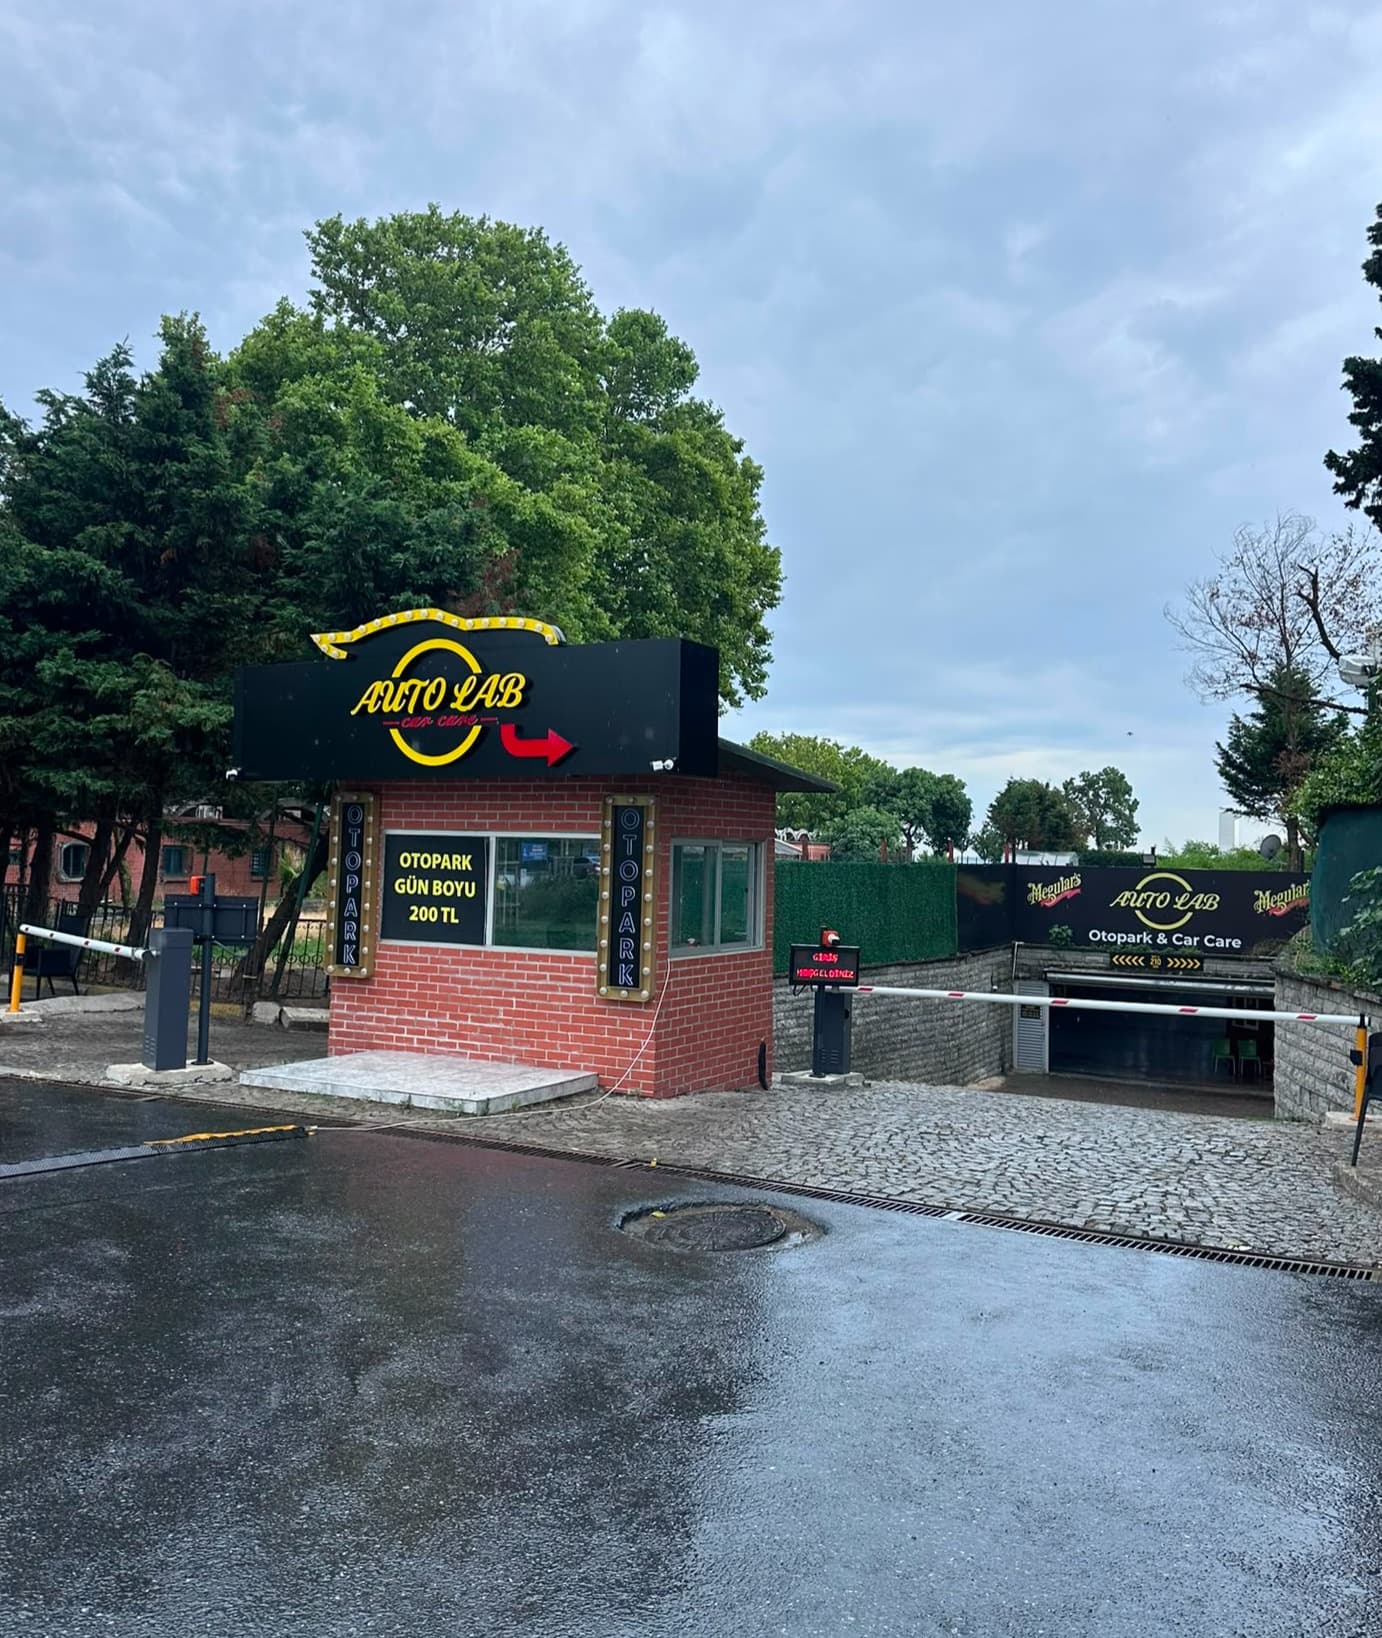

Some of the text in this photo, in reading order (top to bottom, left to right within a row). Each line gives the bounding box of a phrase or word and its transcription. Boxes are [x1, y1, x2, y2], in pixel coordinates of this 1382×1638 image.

[350, 672, 526, 716] AUTO LAB
[401, 716, 433, 728] car
[399, 852, 472, 871] OTOPARK
[343, 804, 363, 965] OTOPARK
[394, 874, 476, 898] GÜN BOYU
[618, 808, 640, 986] OTOPARK
[1109, 890, 1220, 911] AUTO LAB
[409, 905, 459, 924] 200 TL
[1088, 929, 1242, 949] Otopark & Car Care
